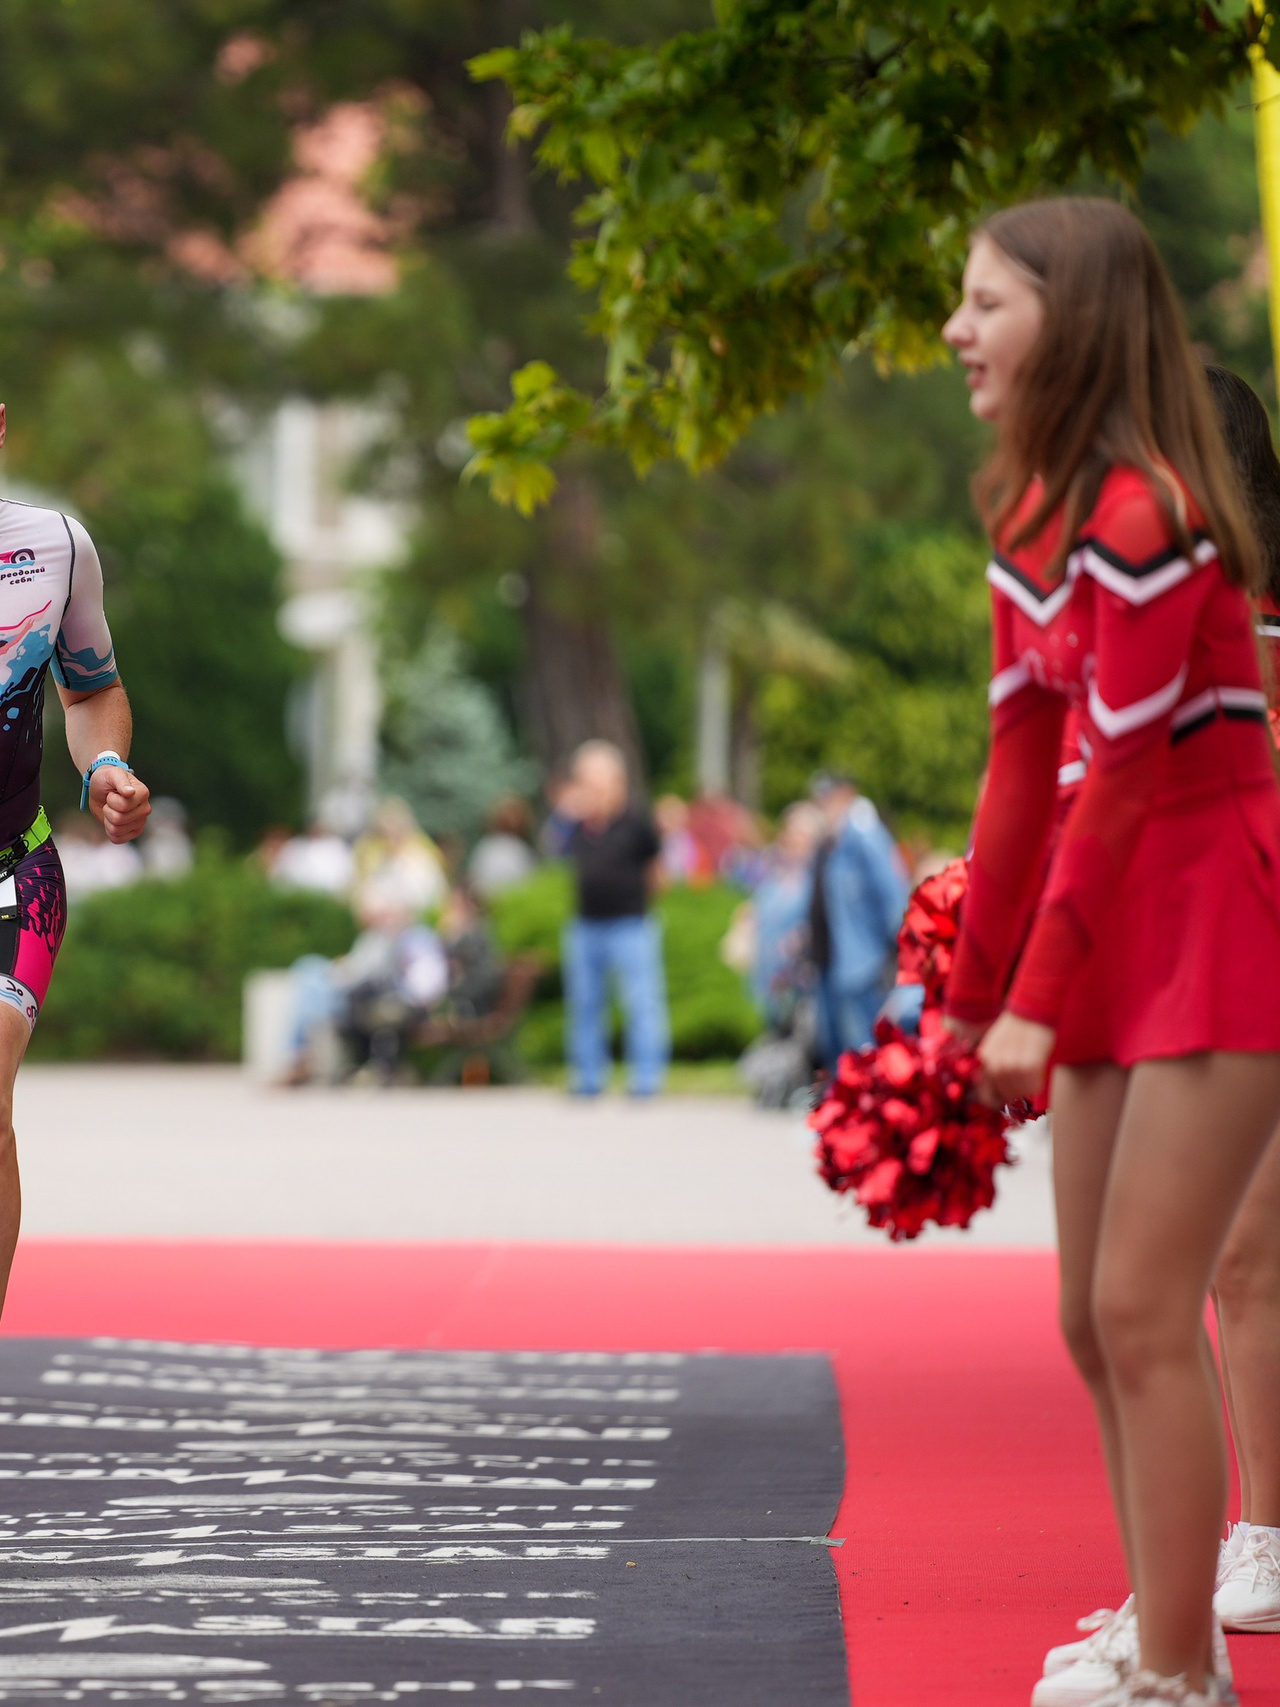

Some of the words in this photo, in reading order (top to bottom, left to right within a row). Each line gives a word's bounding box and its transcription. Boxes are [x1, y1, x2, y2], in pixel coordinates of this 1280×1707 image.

[346, 1471, 657, 1488] STAR
[283, 1521, 625, 1532] STAR
[252, 1546, 610, 1558] STAR
[190, 1615, 596, 1634] STAR
